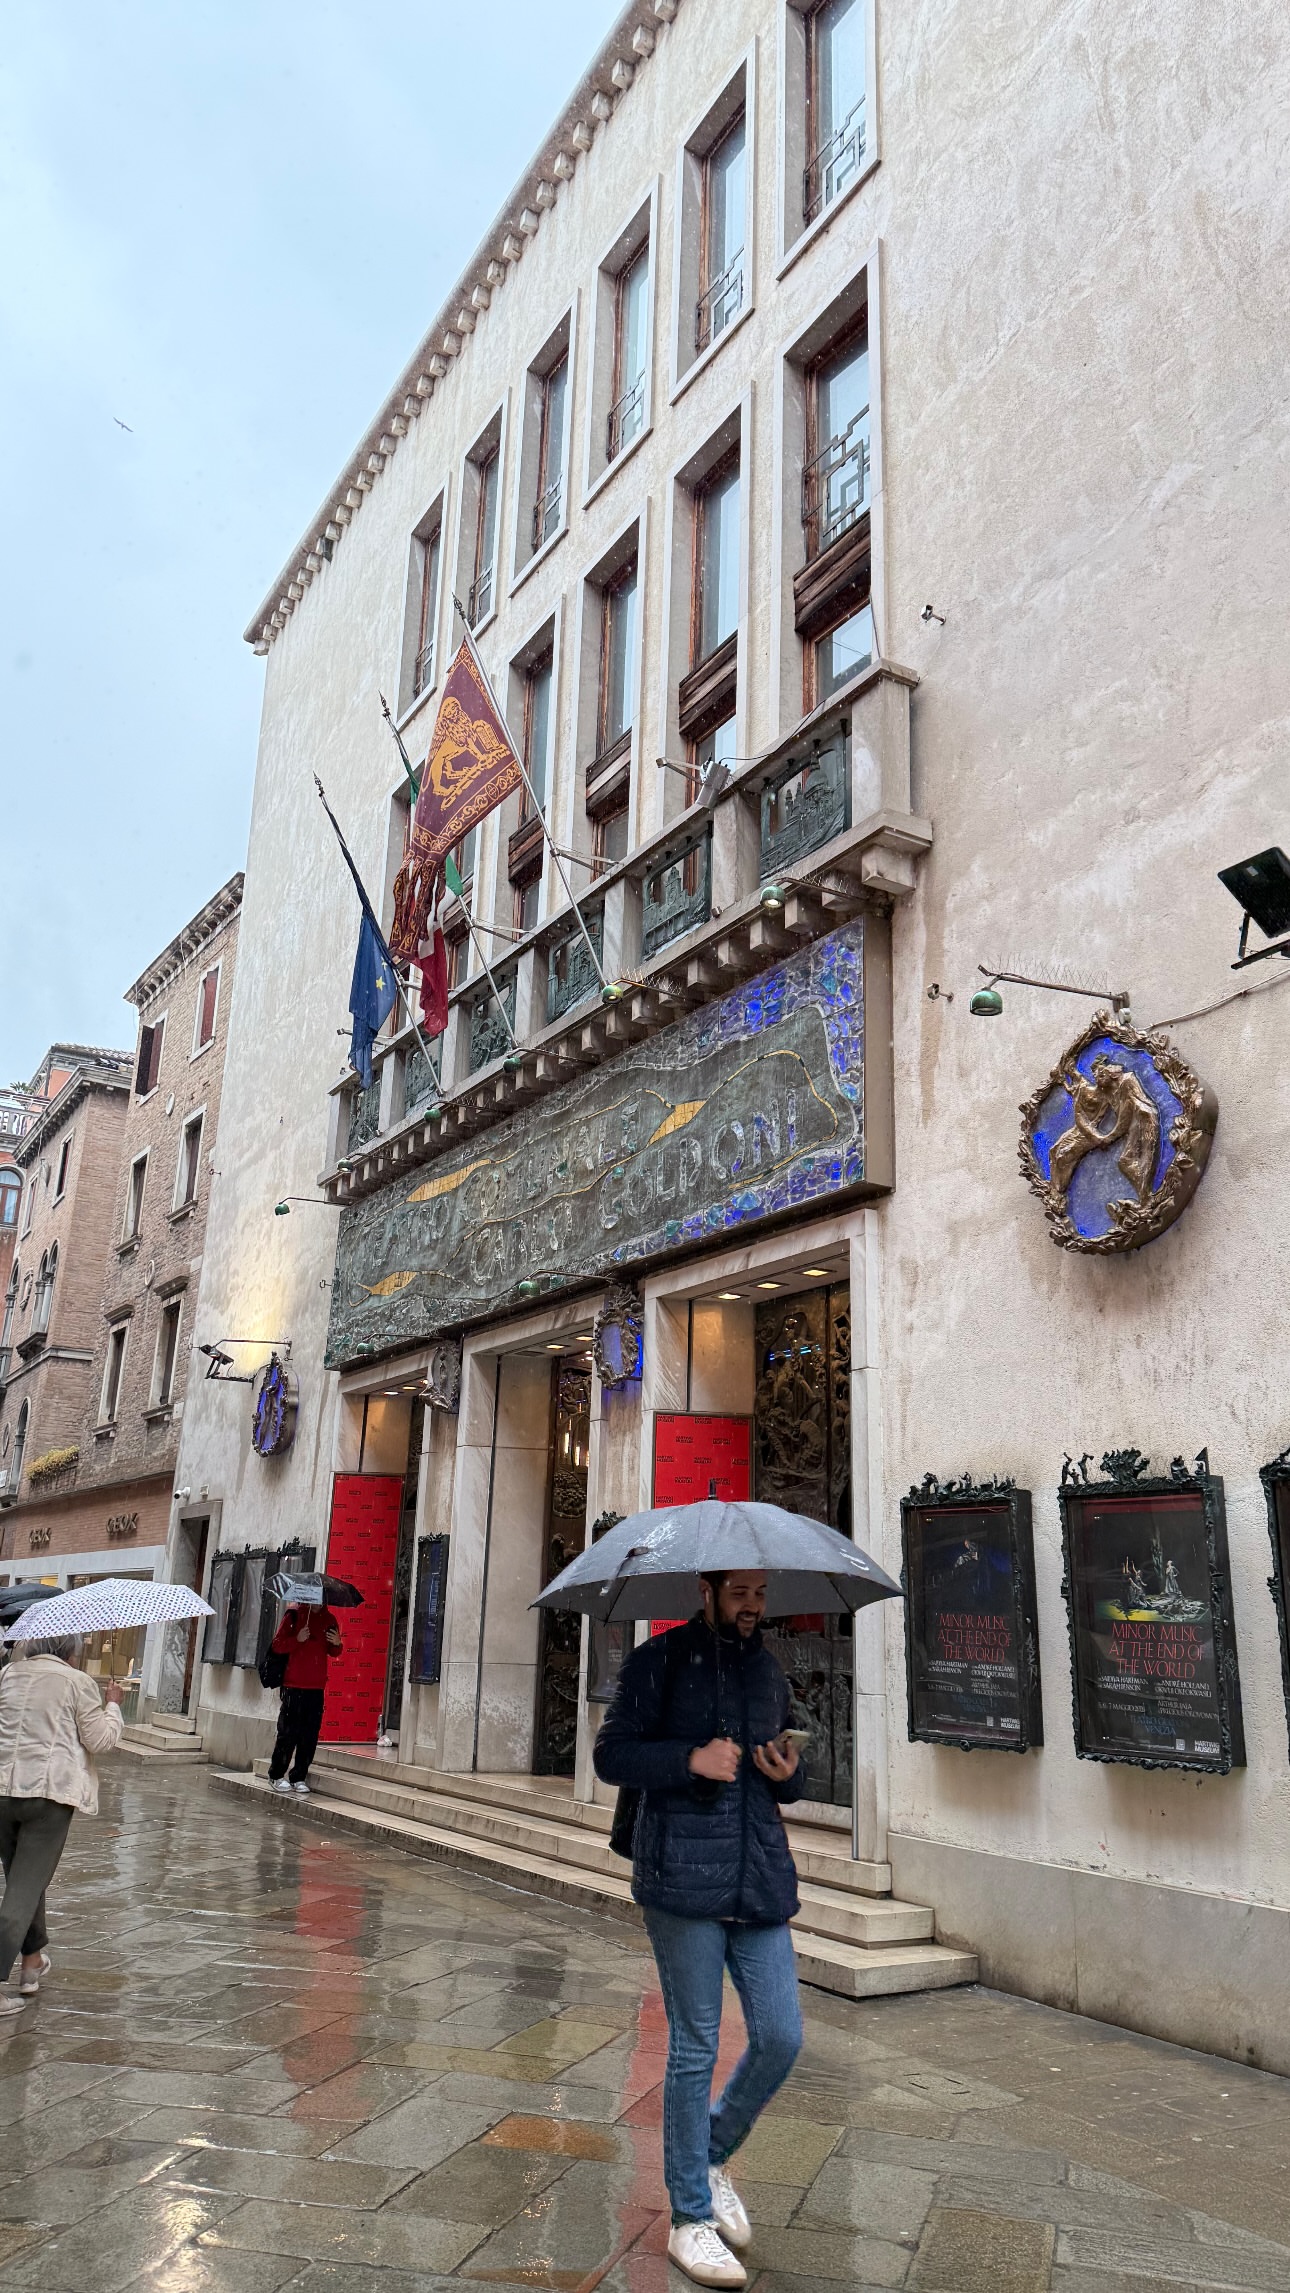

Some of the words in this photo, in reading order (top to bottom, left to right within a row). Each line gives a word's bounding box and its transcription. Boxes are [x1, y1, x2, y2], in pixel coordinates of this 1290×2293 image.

[599, 1082, 797, 1230] GOLDONI
[107, 1513, 138, 1533] GEOX
[940, 1613, 973, 1628] MINOR
[978, 1615, 1009, 1630] MUSIC
[952, 1630, 973, 1644] THE
[975, 1631, 996, 1646] END
[998, 1632, 1012, 1647] OF
[1112, 1622, 1156, 1640] MINOR
[1160, 1624, 1202, 1642] MUSIC
[944, 1644, 962, 1659] THE
[965, 1645, 1004, 1663] WORLD
[1108, 1640, 1125, 1656] AT
[1129, 1640, 1153, 1658] THE
[1156, 1642, 1184, 1659] END
[1187, 1643, 1204, 1661] OF
[1116, 1658, 1140, 1675] THE
[1143, 1660, 1195, 1679] WORLD
[1145, 1724, 1176, 1736] VENEZIA
[1194, 1746, 1219, 1754] MUSEUM
